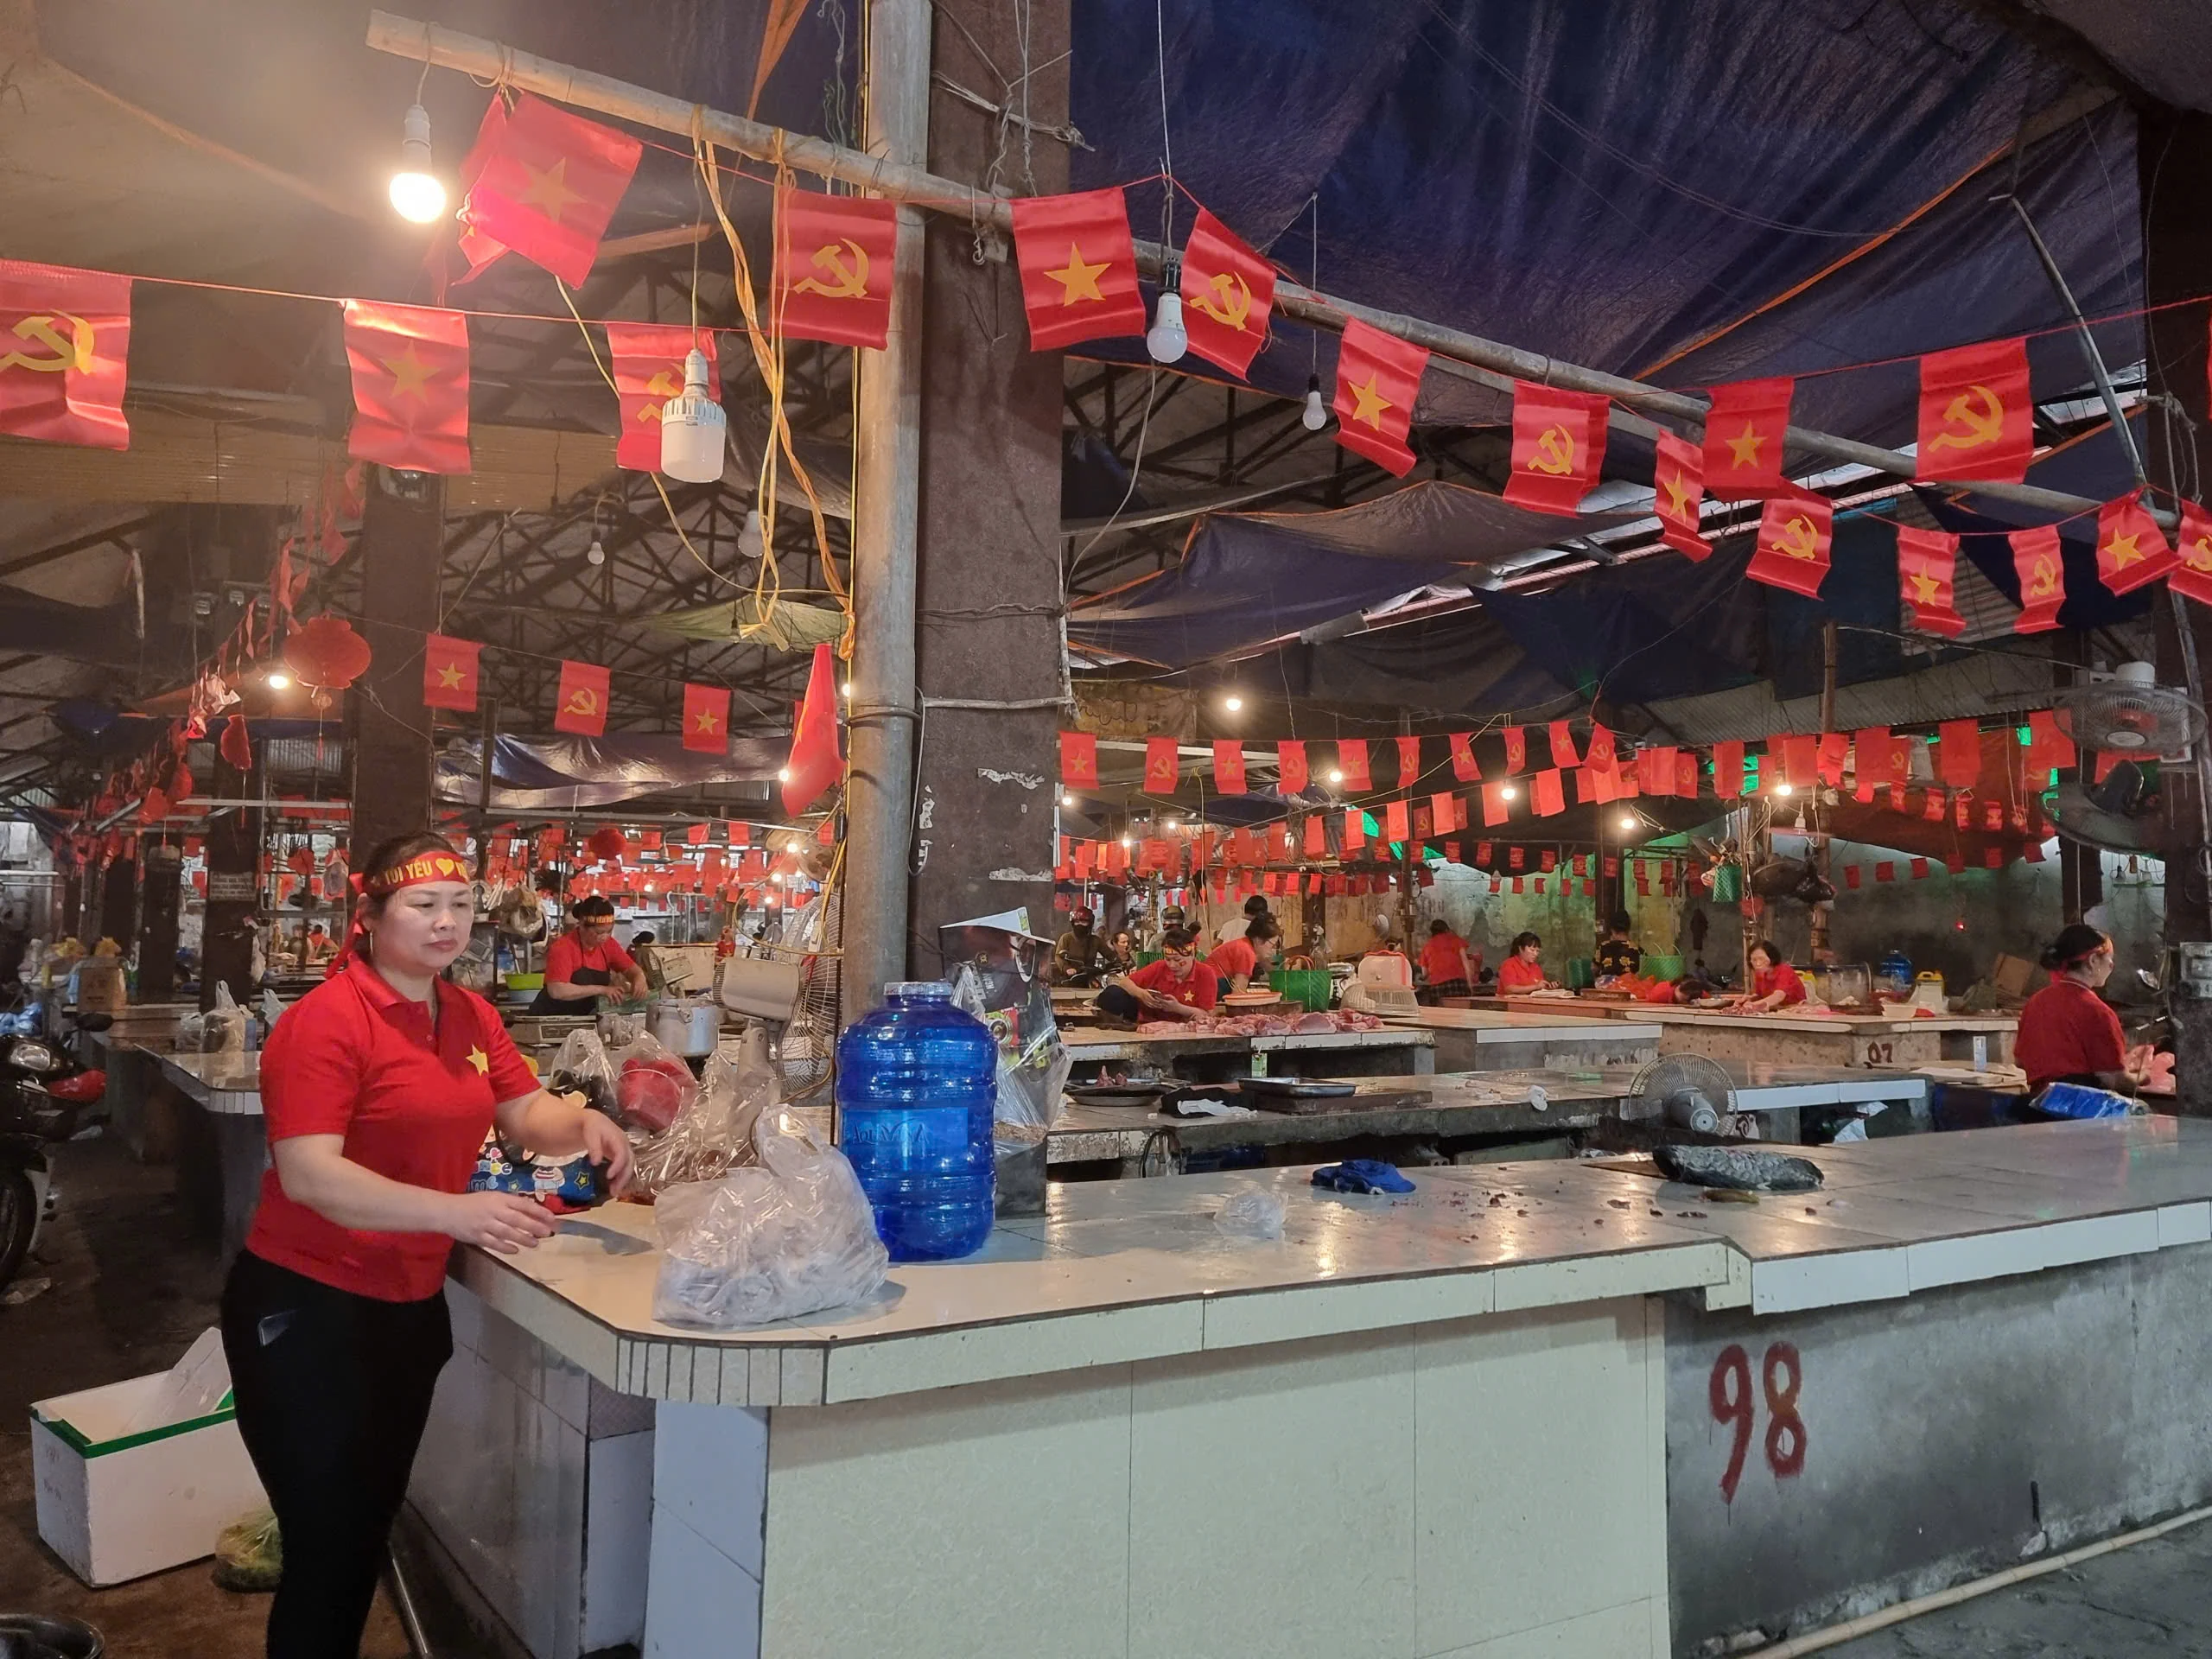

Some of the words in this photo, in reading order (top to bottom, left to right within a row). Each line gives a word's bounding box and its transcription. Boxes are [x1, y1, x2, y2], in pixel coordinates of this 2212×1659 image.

[405, 858, 433, 880] YÊU
[1867, 1040, 1893, 1064] 07
[1709, 1340, 1808, 1506] 98
